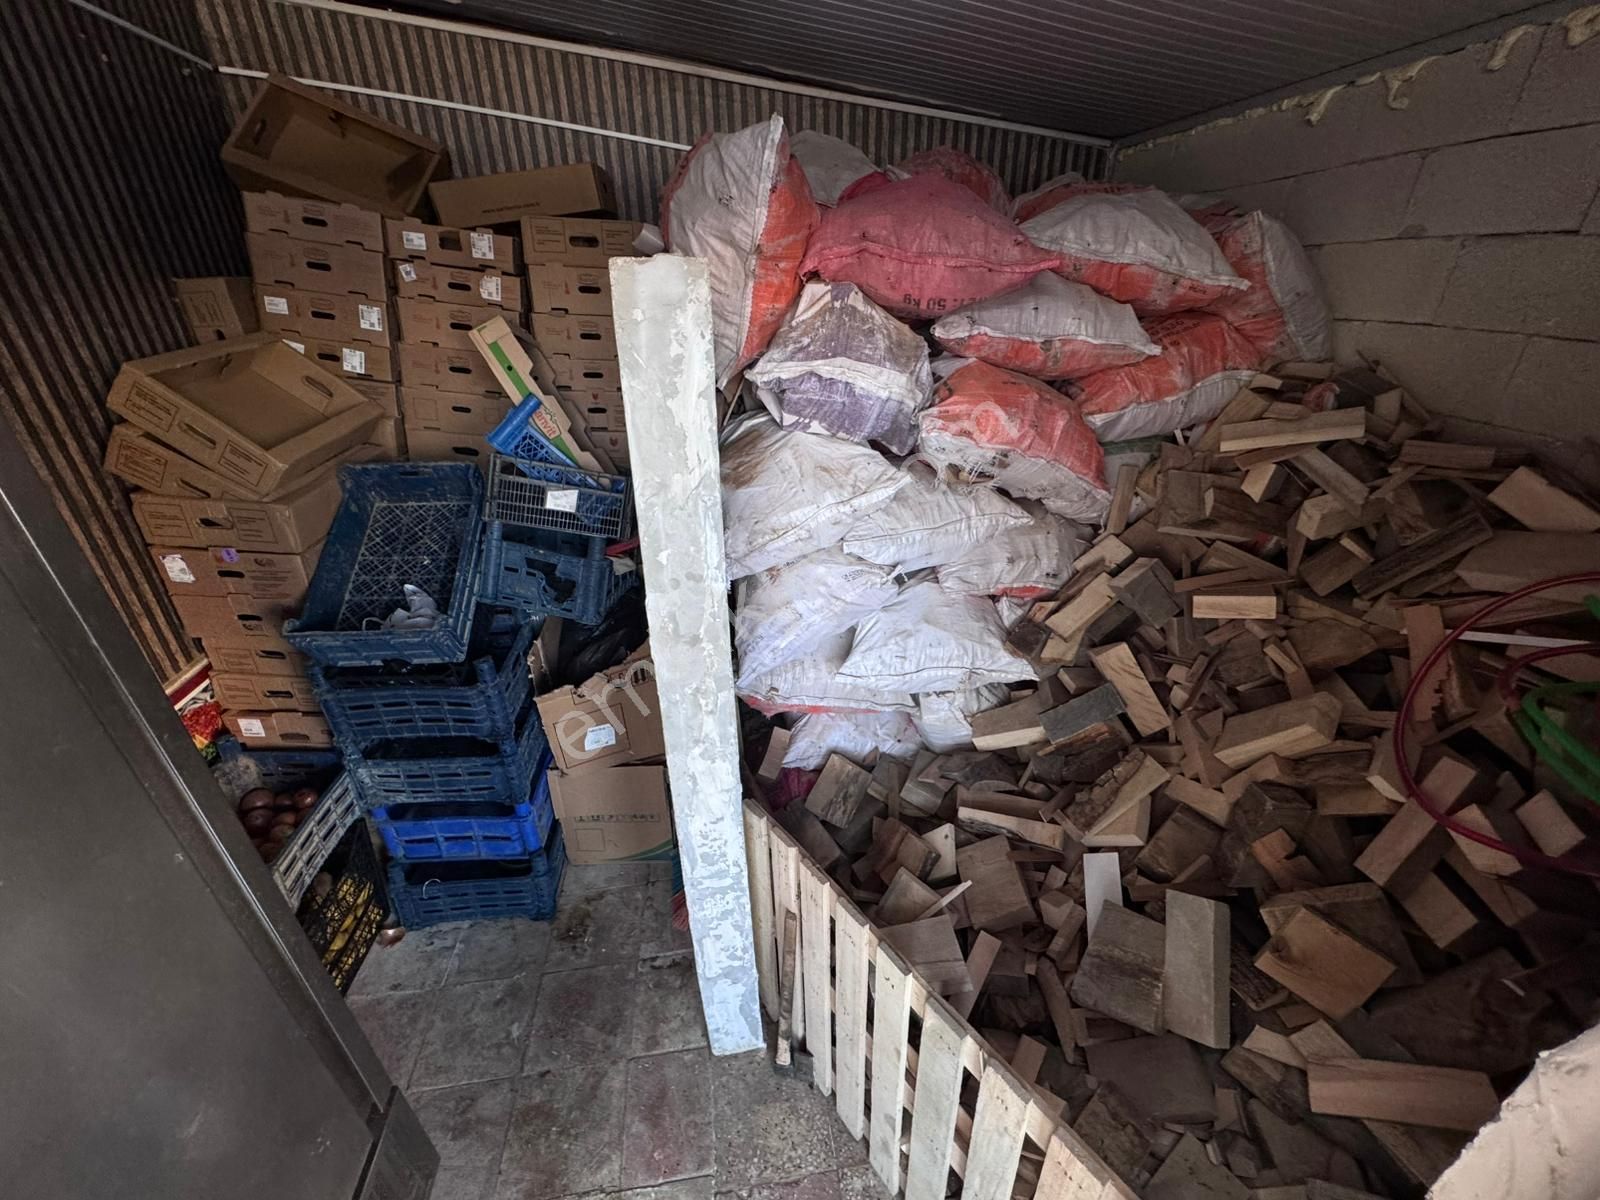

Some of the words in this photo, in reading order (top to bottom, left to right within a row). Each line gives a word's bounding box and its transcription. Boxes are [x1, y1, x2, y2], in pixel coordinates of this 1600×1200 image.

[903, 294, 921, 309] kg
[926, 298, 946, 311] 50
[534, 411, 557, 437] anvit
